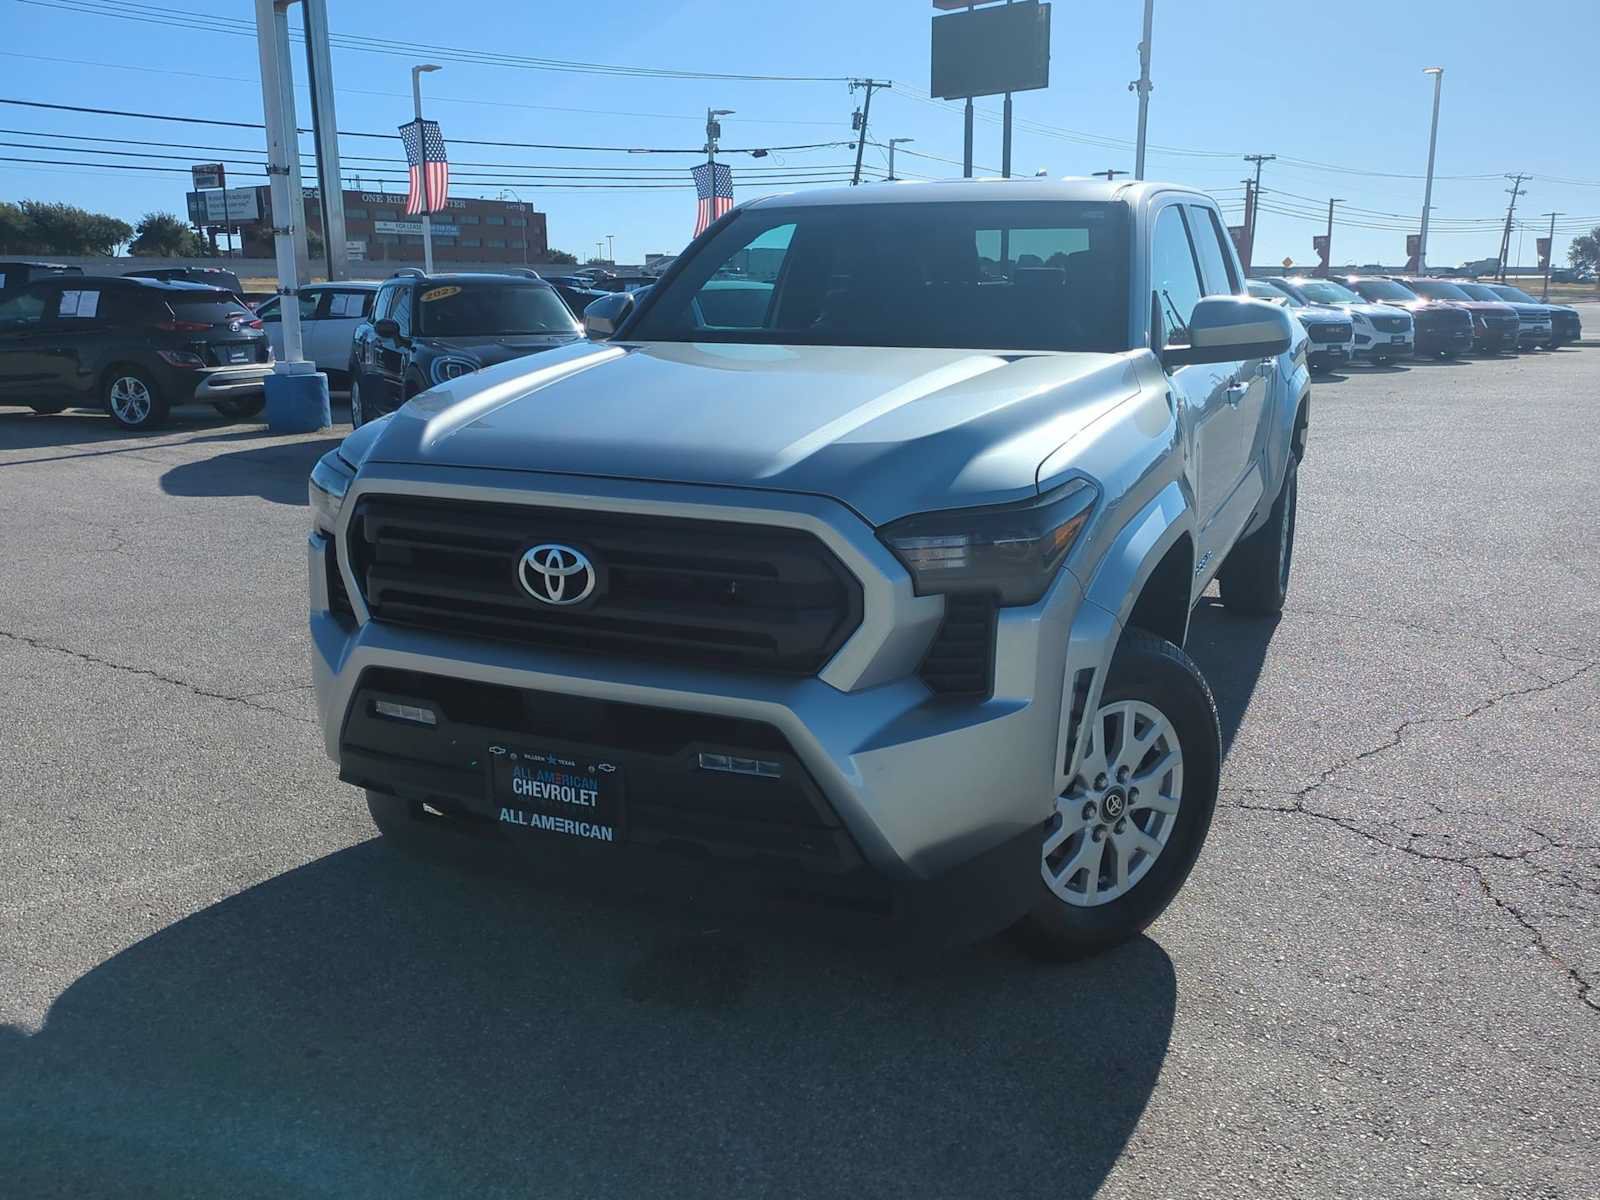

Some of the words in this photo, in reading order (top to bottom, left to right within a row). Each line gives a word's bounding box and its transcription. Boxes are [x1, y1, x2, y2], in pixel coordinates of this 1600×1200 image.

[362, 193, 384, 203] ONE
[512, 766, 535, 780] ALL
[536, 769, 598, 790] AMERICAN
[512, 777, 598, 807] CHEVROLET
[500, 807, 529, 826] ALL
[530, 813, 614, 842] AMERICAN
